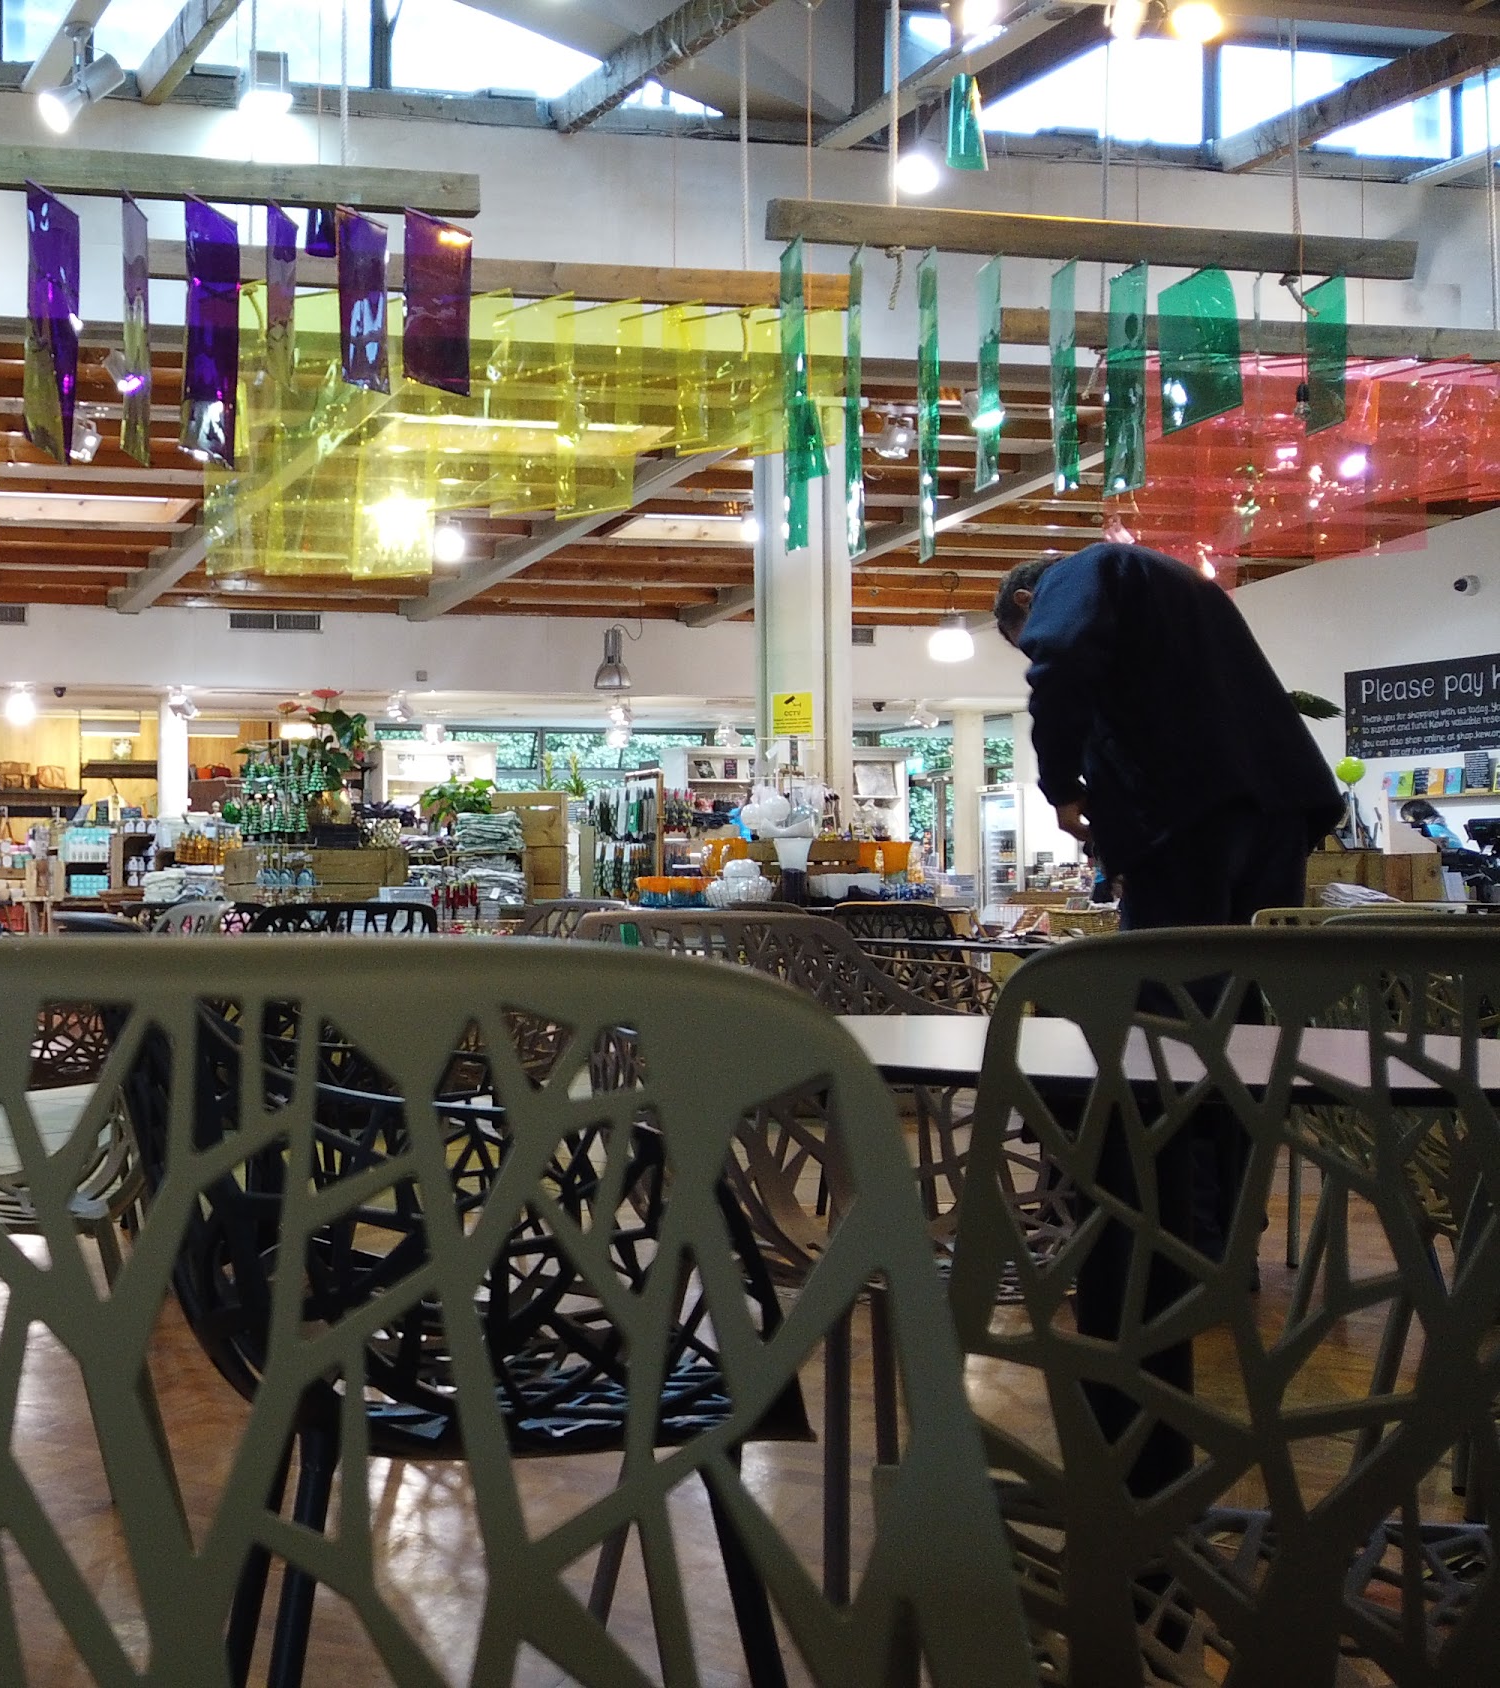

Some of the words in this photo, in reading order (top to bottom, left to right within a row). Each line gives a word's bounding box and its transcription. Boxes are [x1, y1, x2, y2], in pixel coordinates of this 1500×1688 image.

[1361, 678, 1435, 704] Please
[1445, 672, 1484, 701] pay
[1361, 714, 1383, 723] Thank
[1383, 714, 1396, 724] you
[1396, 712, 1406, 720] for
[1408, 709, 1439, 720] shopping
[1441, 707, 1456, 716] with
[1370, 724, 1396, 734] support
[1397, 722, 1411, 731] and
[1411, 721, 1428, 730] fund
[1429, 719, 1450, 729] Kew's
[1451, 716, 1481, 726] valuable
[1362, 739, 1375, 749] You
[1375, 738, 1389, 747] can
[1389, 737, 1404, 746] also
[1405, 736, 1423, 745] shop
[1423, 734, 1446, 743] online
[1447, 733, 1455, 741] at
[1400, 747, 1412, 756] off
[1411, 747, 1423, 755] for
